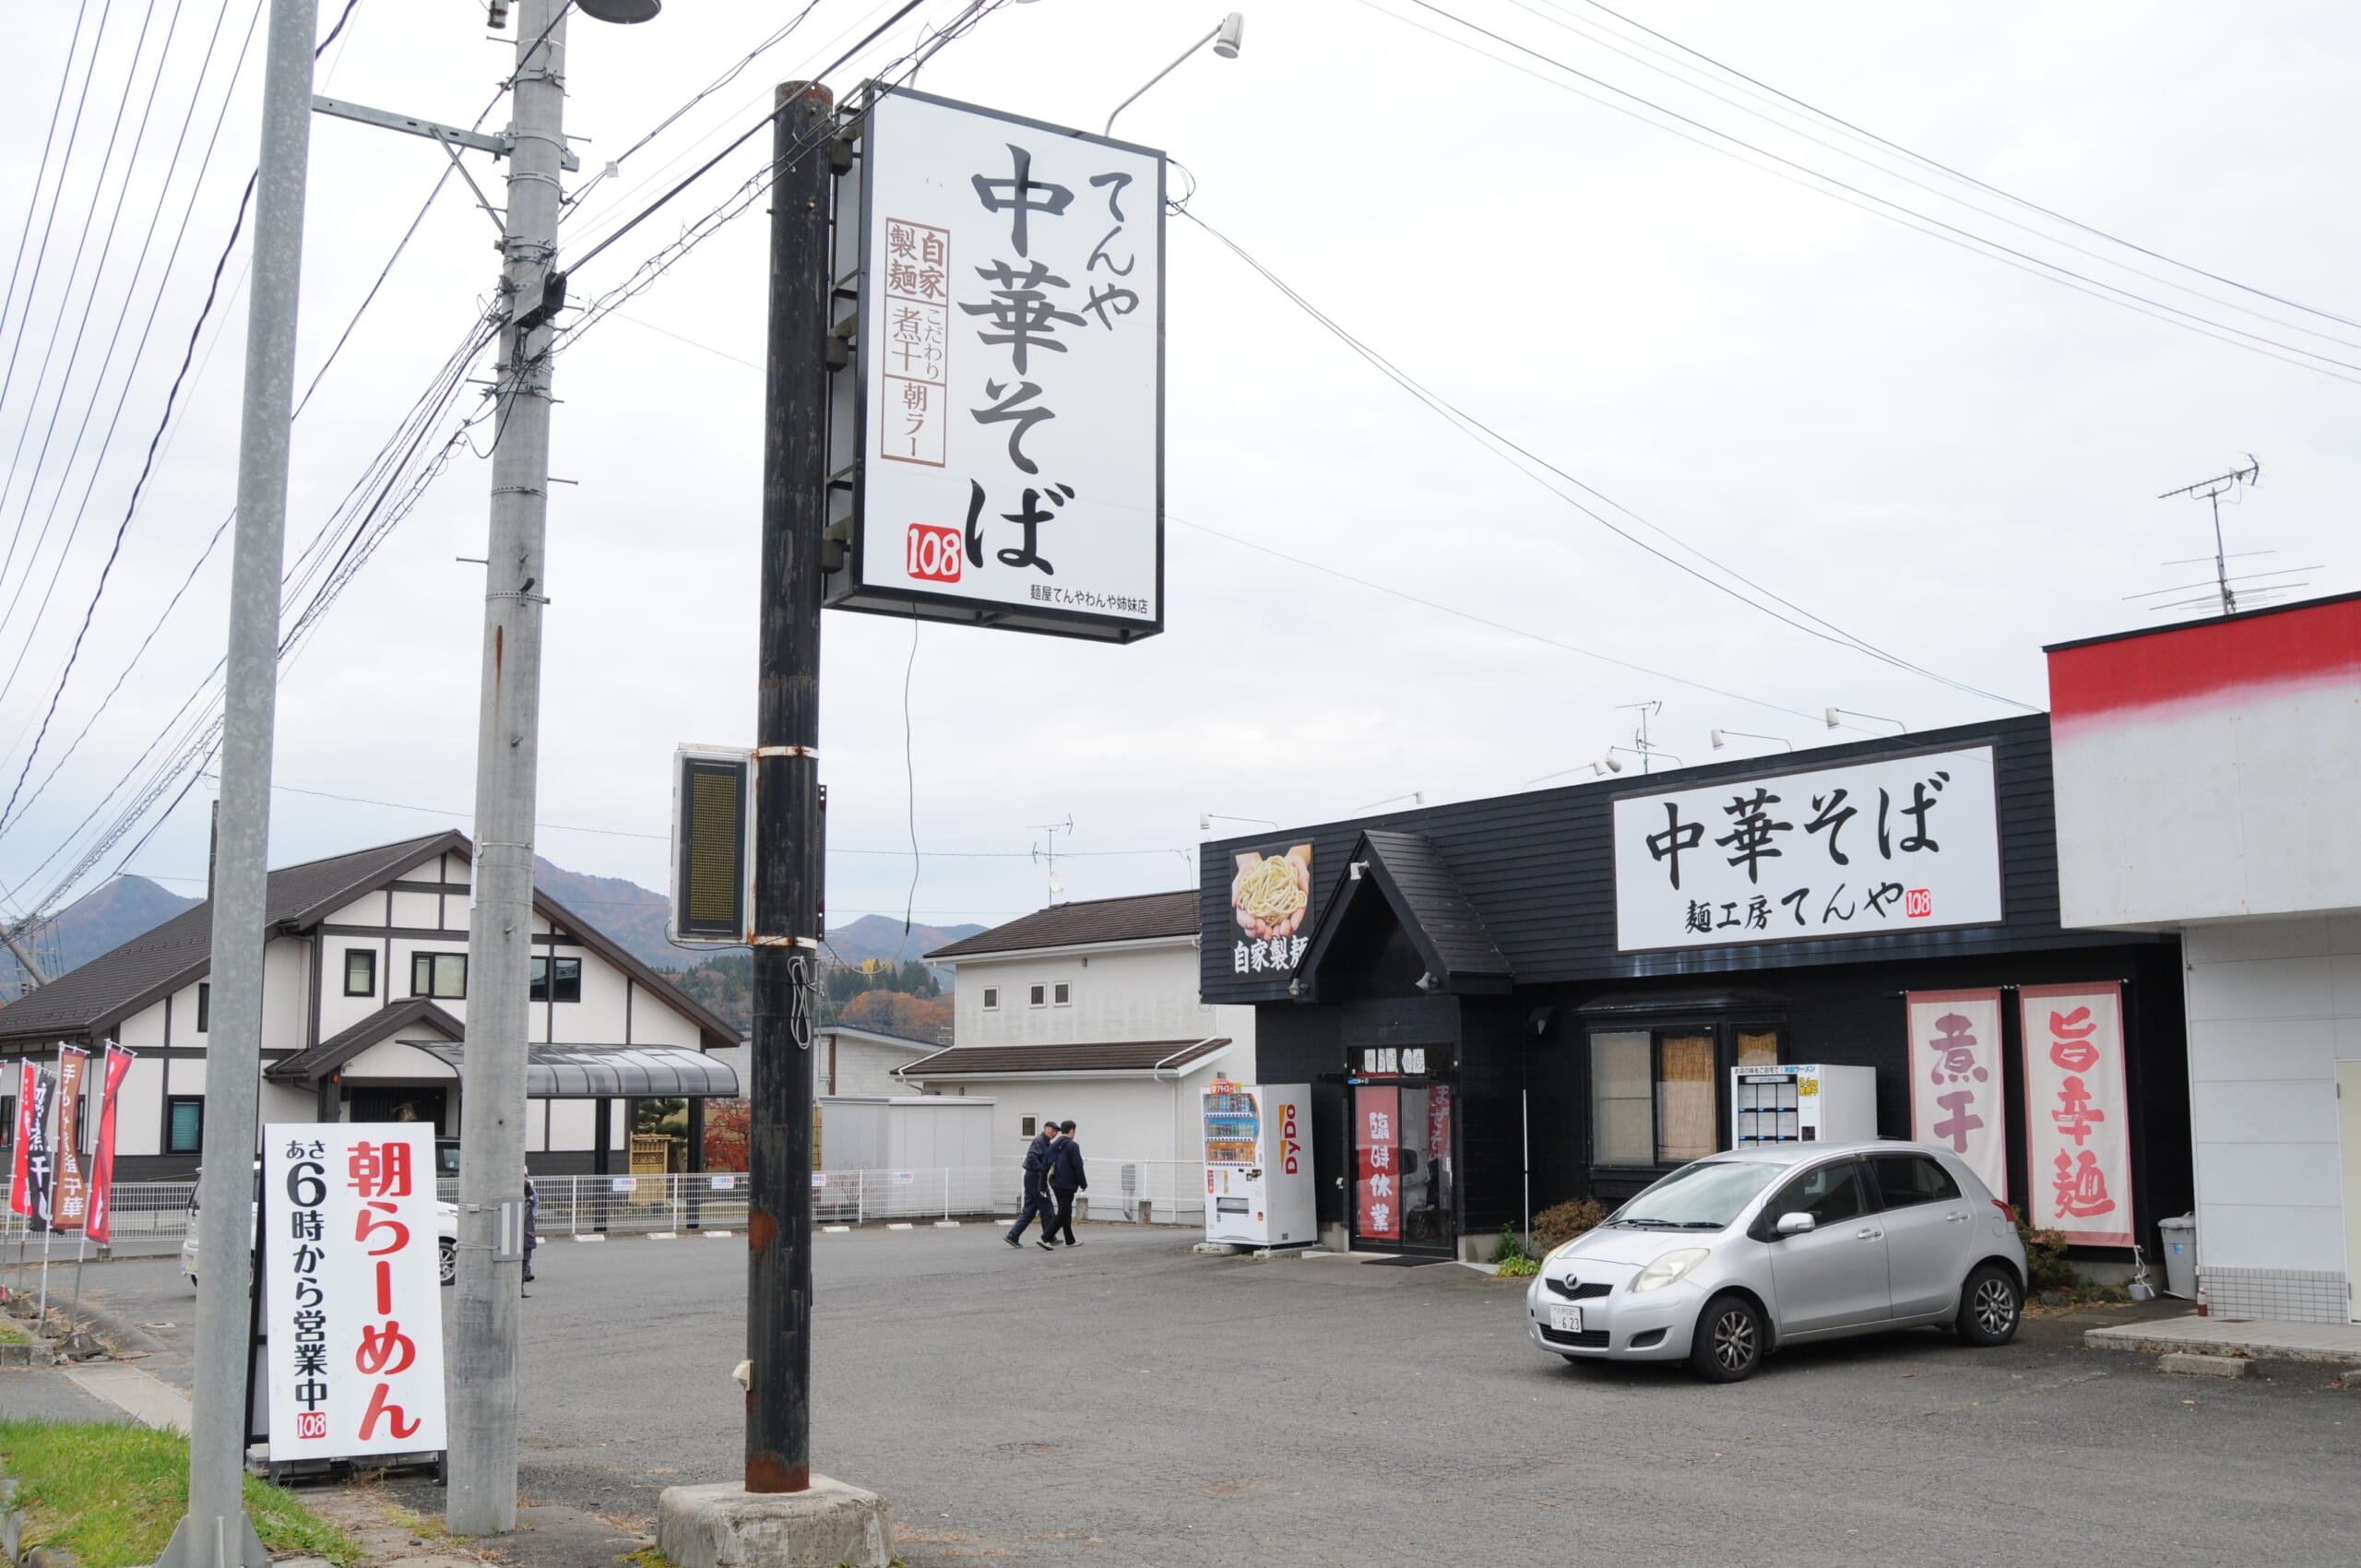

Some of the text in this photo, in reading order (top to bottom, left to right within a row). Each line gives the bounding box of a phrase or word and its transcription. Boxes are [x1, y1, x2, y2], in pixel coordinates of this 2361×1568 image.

[888, 224, 919, 296] 製麺
[918, 231, 946, 300] 自家
[1081, 172, 1140, 331] てんや
[891, 306, 923, 372] 煮干
[924, 308, 943, 381] こだわり
[957, 142, 1088, 576] 中華そば
[902, 382, 928, 457] 朝ラー
[908, 527, 961, 577] 108
[1030, 583, 1149, 614] 麺屋てんやわんや姉妹店
[1645, 770, 1951, 891] 中華そば
[1906, 890, 1930, 917] 108
[1928, 1013, 1988, 1154] 煮干
[286, 1139, 326, 1160] あさ
[1285, 1103, 1301, 1175] DyDo
[1369, 1111, 1393, 1231] 臨時休業
[286, 1161, 328, 1411] 6時から営業中
[347, 1140, 421, 1442] 朝らーめん
[297, 1414, 326, 1437] 108
